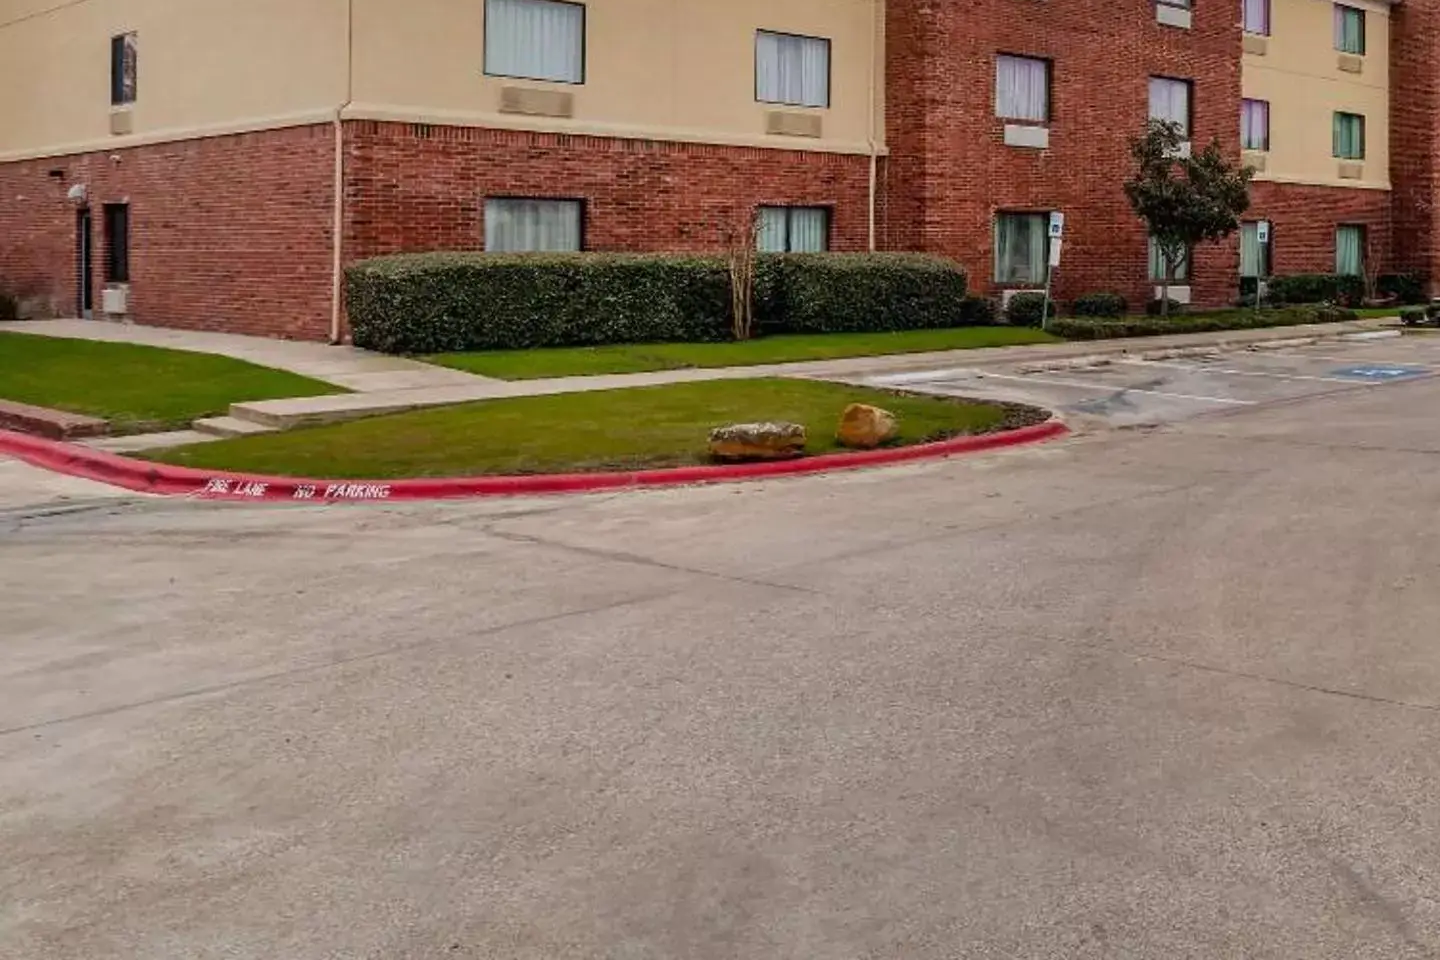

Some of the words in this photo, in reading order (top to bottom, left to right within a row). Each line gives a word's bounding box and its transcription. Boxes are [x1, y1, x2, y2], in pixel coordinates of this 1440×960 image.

[204, 479, 232, 493] FIRE
[234, 481, 268, 496] LANE
[292, 484, 316, 498] NO
[324, 483, 390, 498] PARKING
